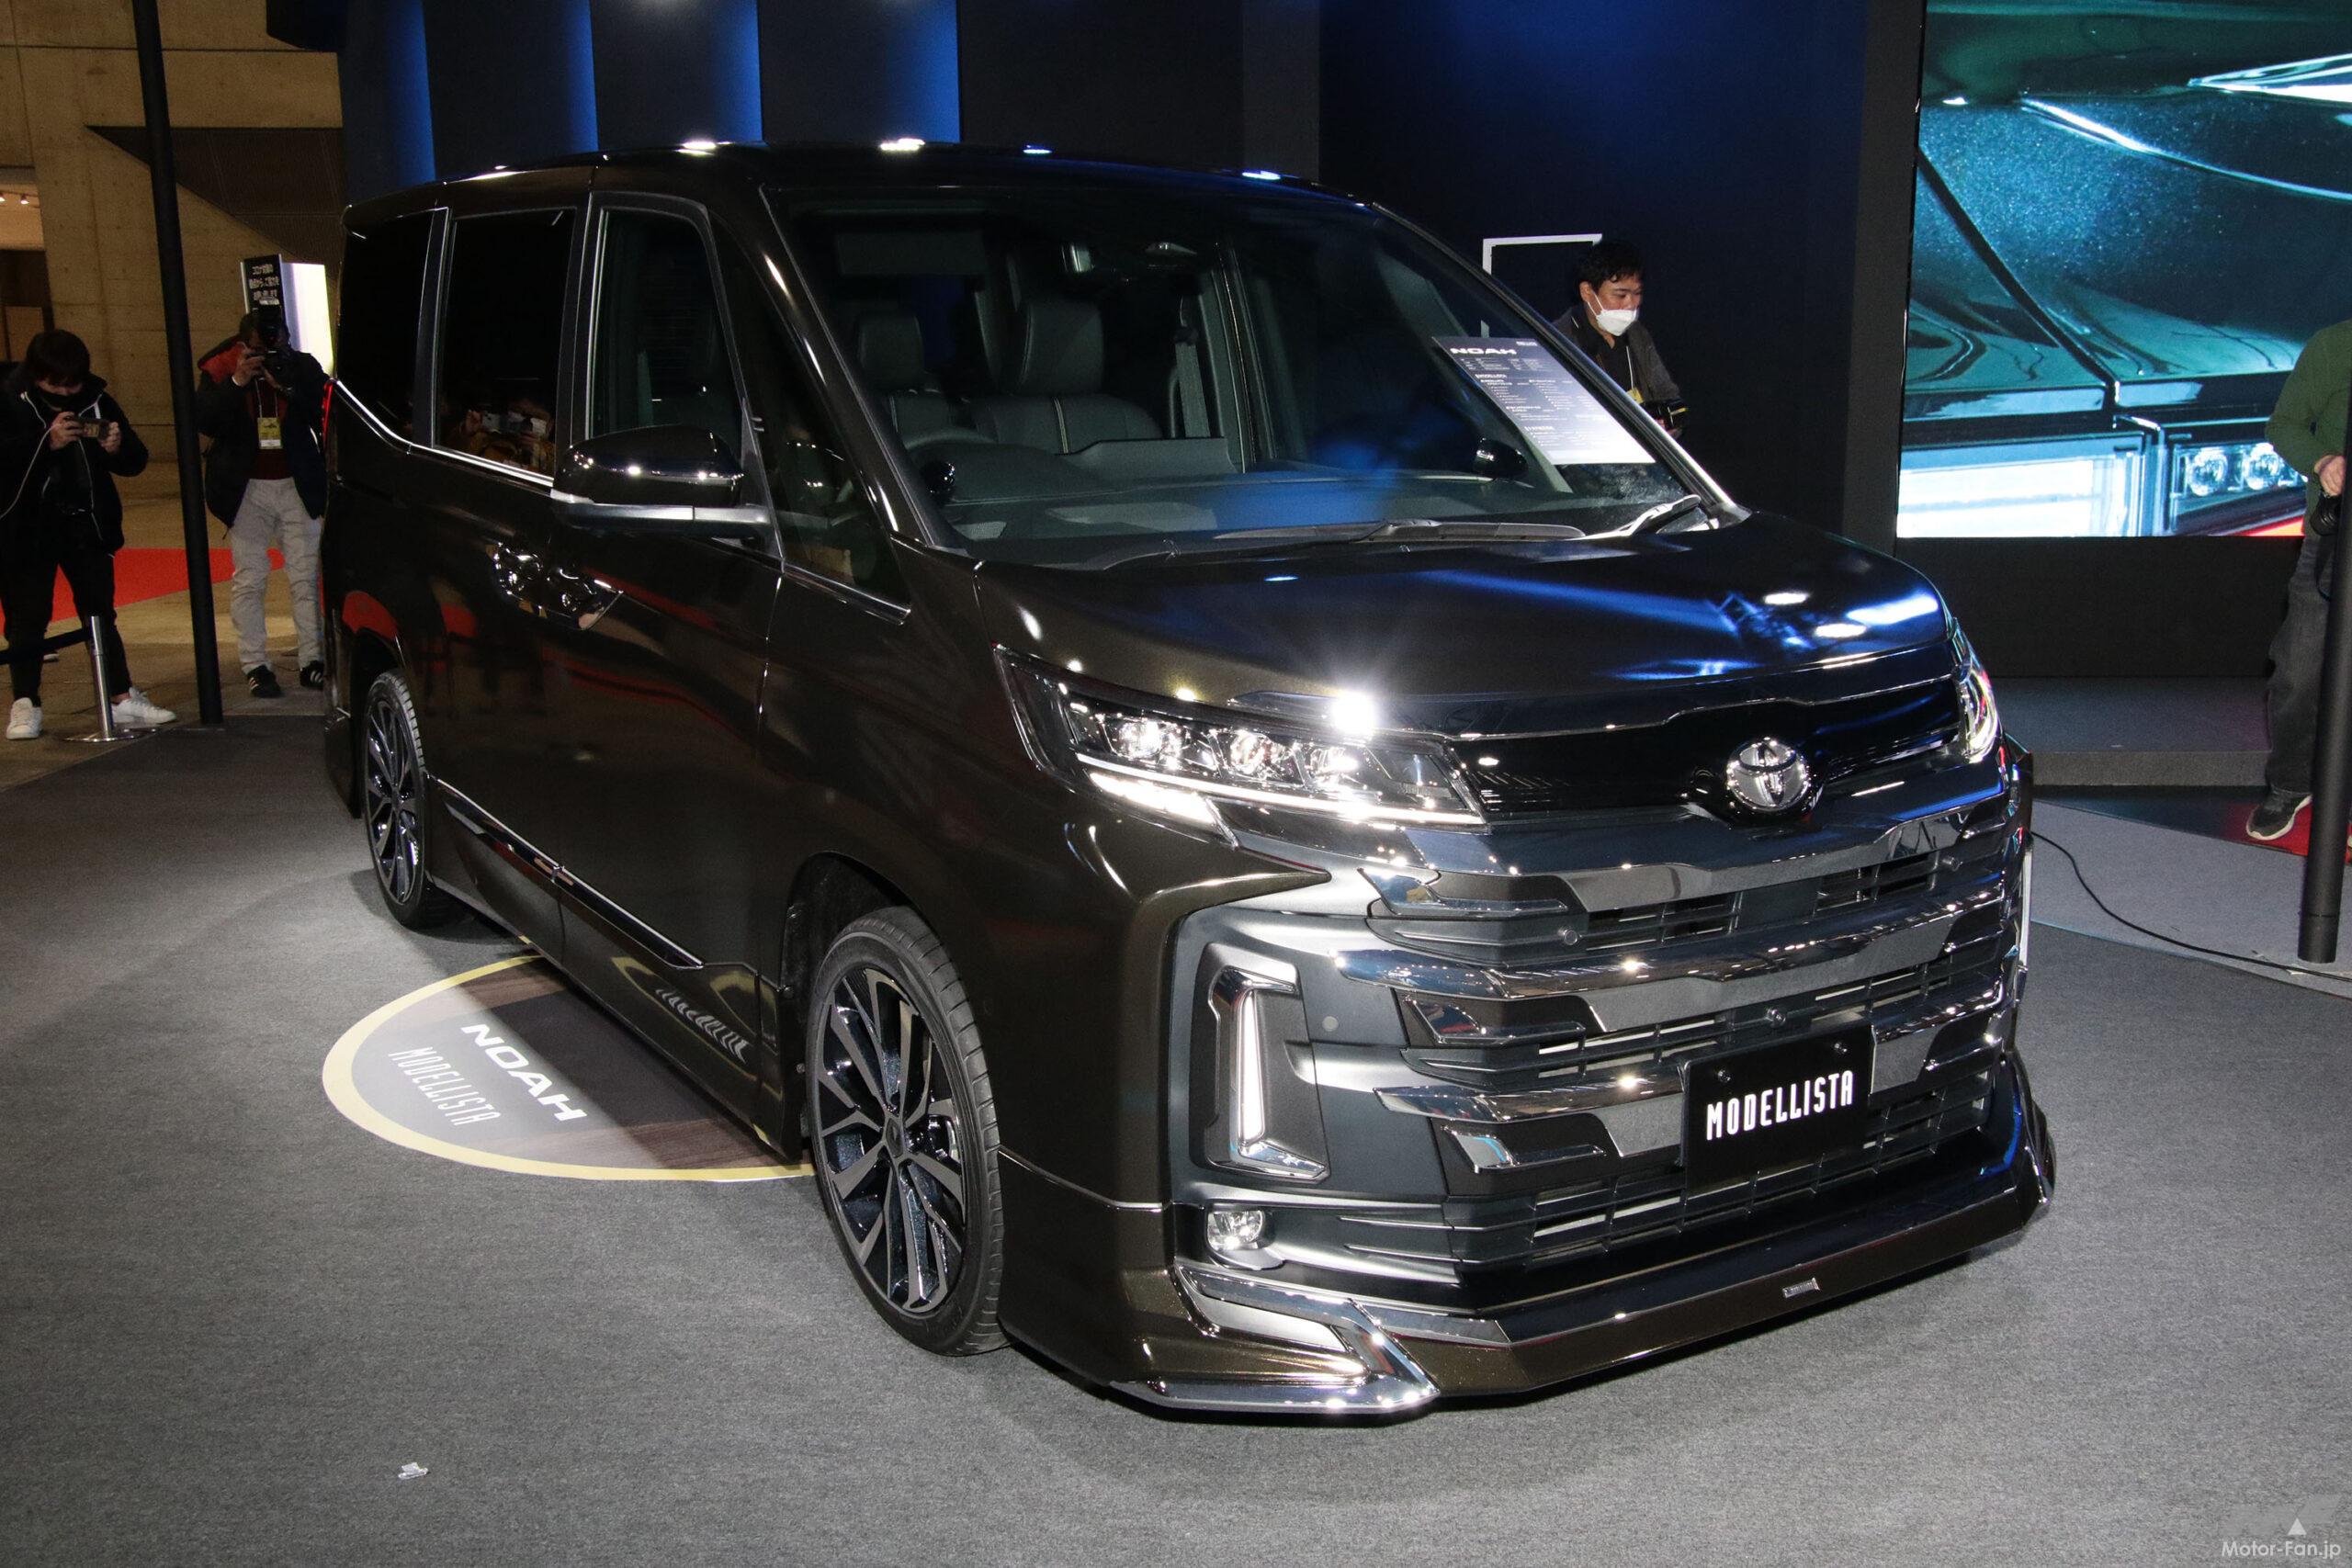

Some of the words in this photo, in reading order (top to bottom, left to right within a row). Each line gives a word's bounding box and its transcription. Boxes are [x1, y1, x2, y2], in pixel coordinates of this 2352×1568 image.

[1450, 347, 1517, 355] NOAH
[388, 1045, 501, 1126] MODELLISTA
[461, 1023, 587, 1122] NOAH
[1706, 1070, 1854, 1141] MODELLISTA
